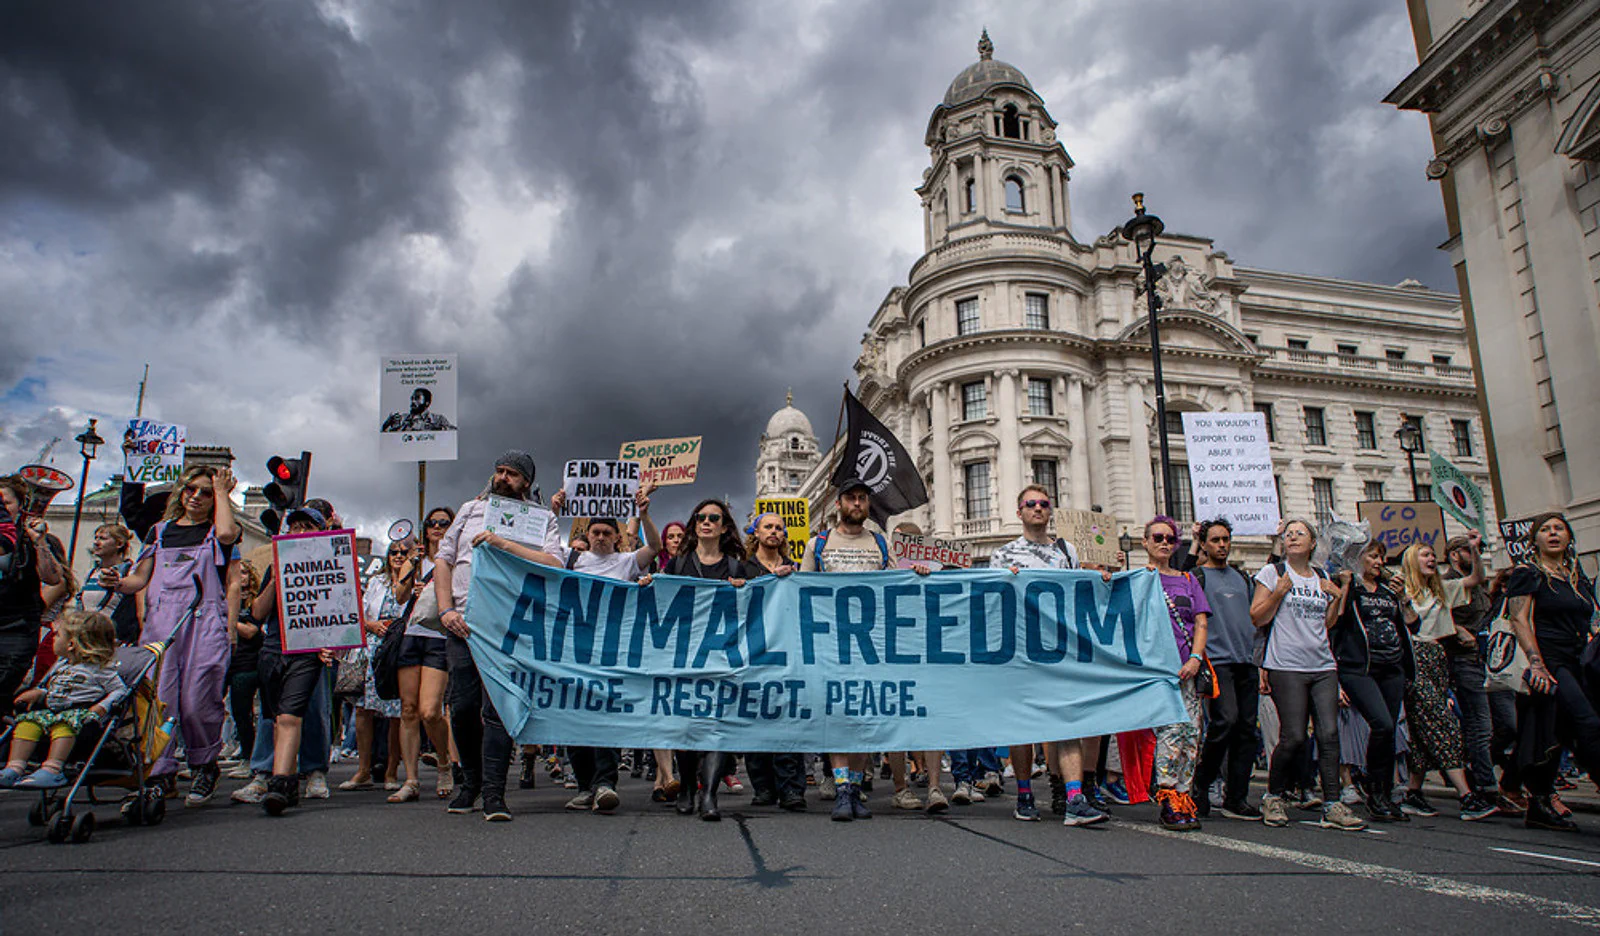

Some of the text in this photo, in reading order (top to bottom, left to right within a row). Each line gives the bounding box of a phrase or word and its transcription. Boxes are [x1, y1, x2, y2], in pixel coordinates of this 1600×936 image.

[129, 419, 178, 442] HAVE A
[1195, 419, 1258, 427] YOU WOULDN'T
[622, 439, 700, 460] SOMEBODY
[1208, 448, 1232, 456] ABUSE
[143, 455, 161, 467] GO
[648, 456, 676, 468] NOT
[1194, 463, 1271, 472] SO DON'T SUPPORT
[128, 464, 182, 482] VEGAN
[567, 461, 639, 479] END THE
[1434, 465, 1449, 479] SEE
[575, 483, 633, 498] ANIMAL
[1198, 480, 1229, 488] ANIMAL
[1232, 480, 1257, 488] ABUSE
[561, 499, 637, 517] HOLOCAUST
[758, 500, 805, 515] EATING
[1199, 496, 1209, 504] BE
[1217, 496, 1250, 504] CRUELTY
[1381, 505, 1416, 522] GO
[900, 533, 968, 551] THE ONLY
[893, 541, 971, 568] DIFFERENCE
[283, 559, 344, 575] ANIMAL
[284, 572, 347, 588] LOVERS
[285, 588, 332, 603] DON'T
[287, 603, 317, 616] EAT
[288, 612, 359, 630] ANIMALS
[500, 573, 1143, 668] ANIMAL FREEDOM
[652, 676, 812, 720] RESPECT.
[825, 680, 927, 718] PEACE.
